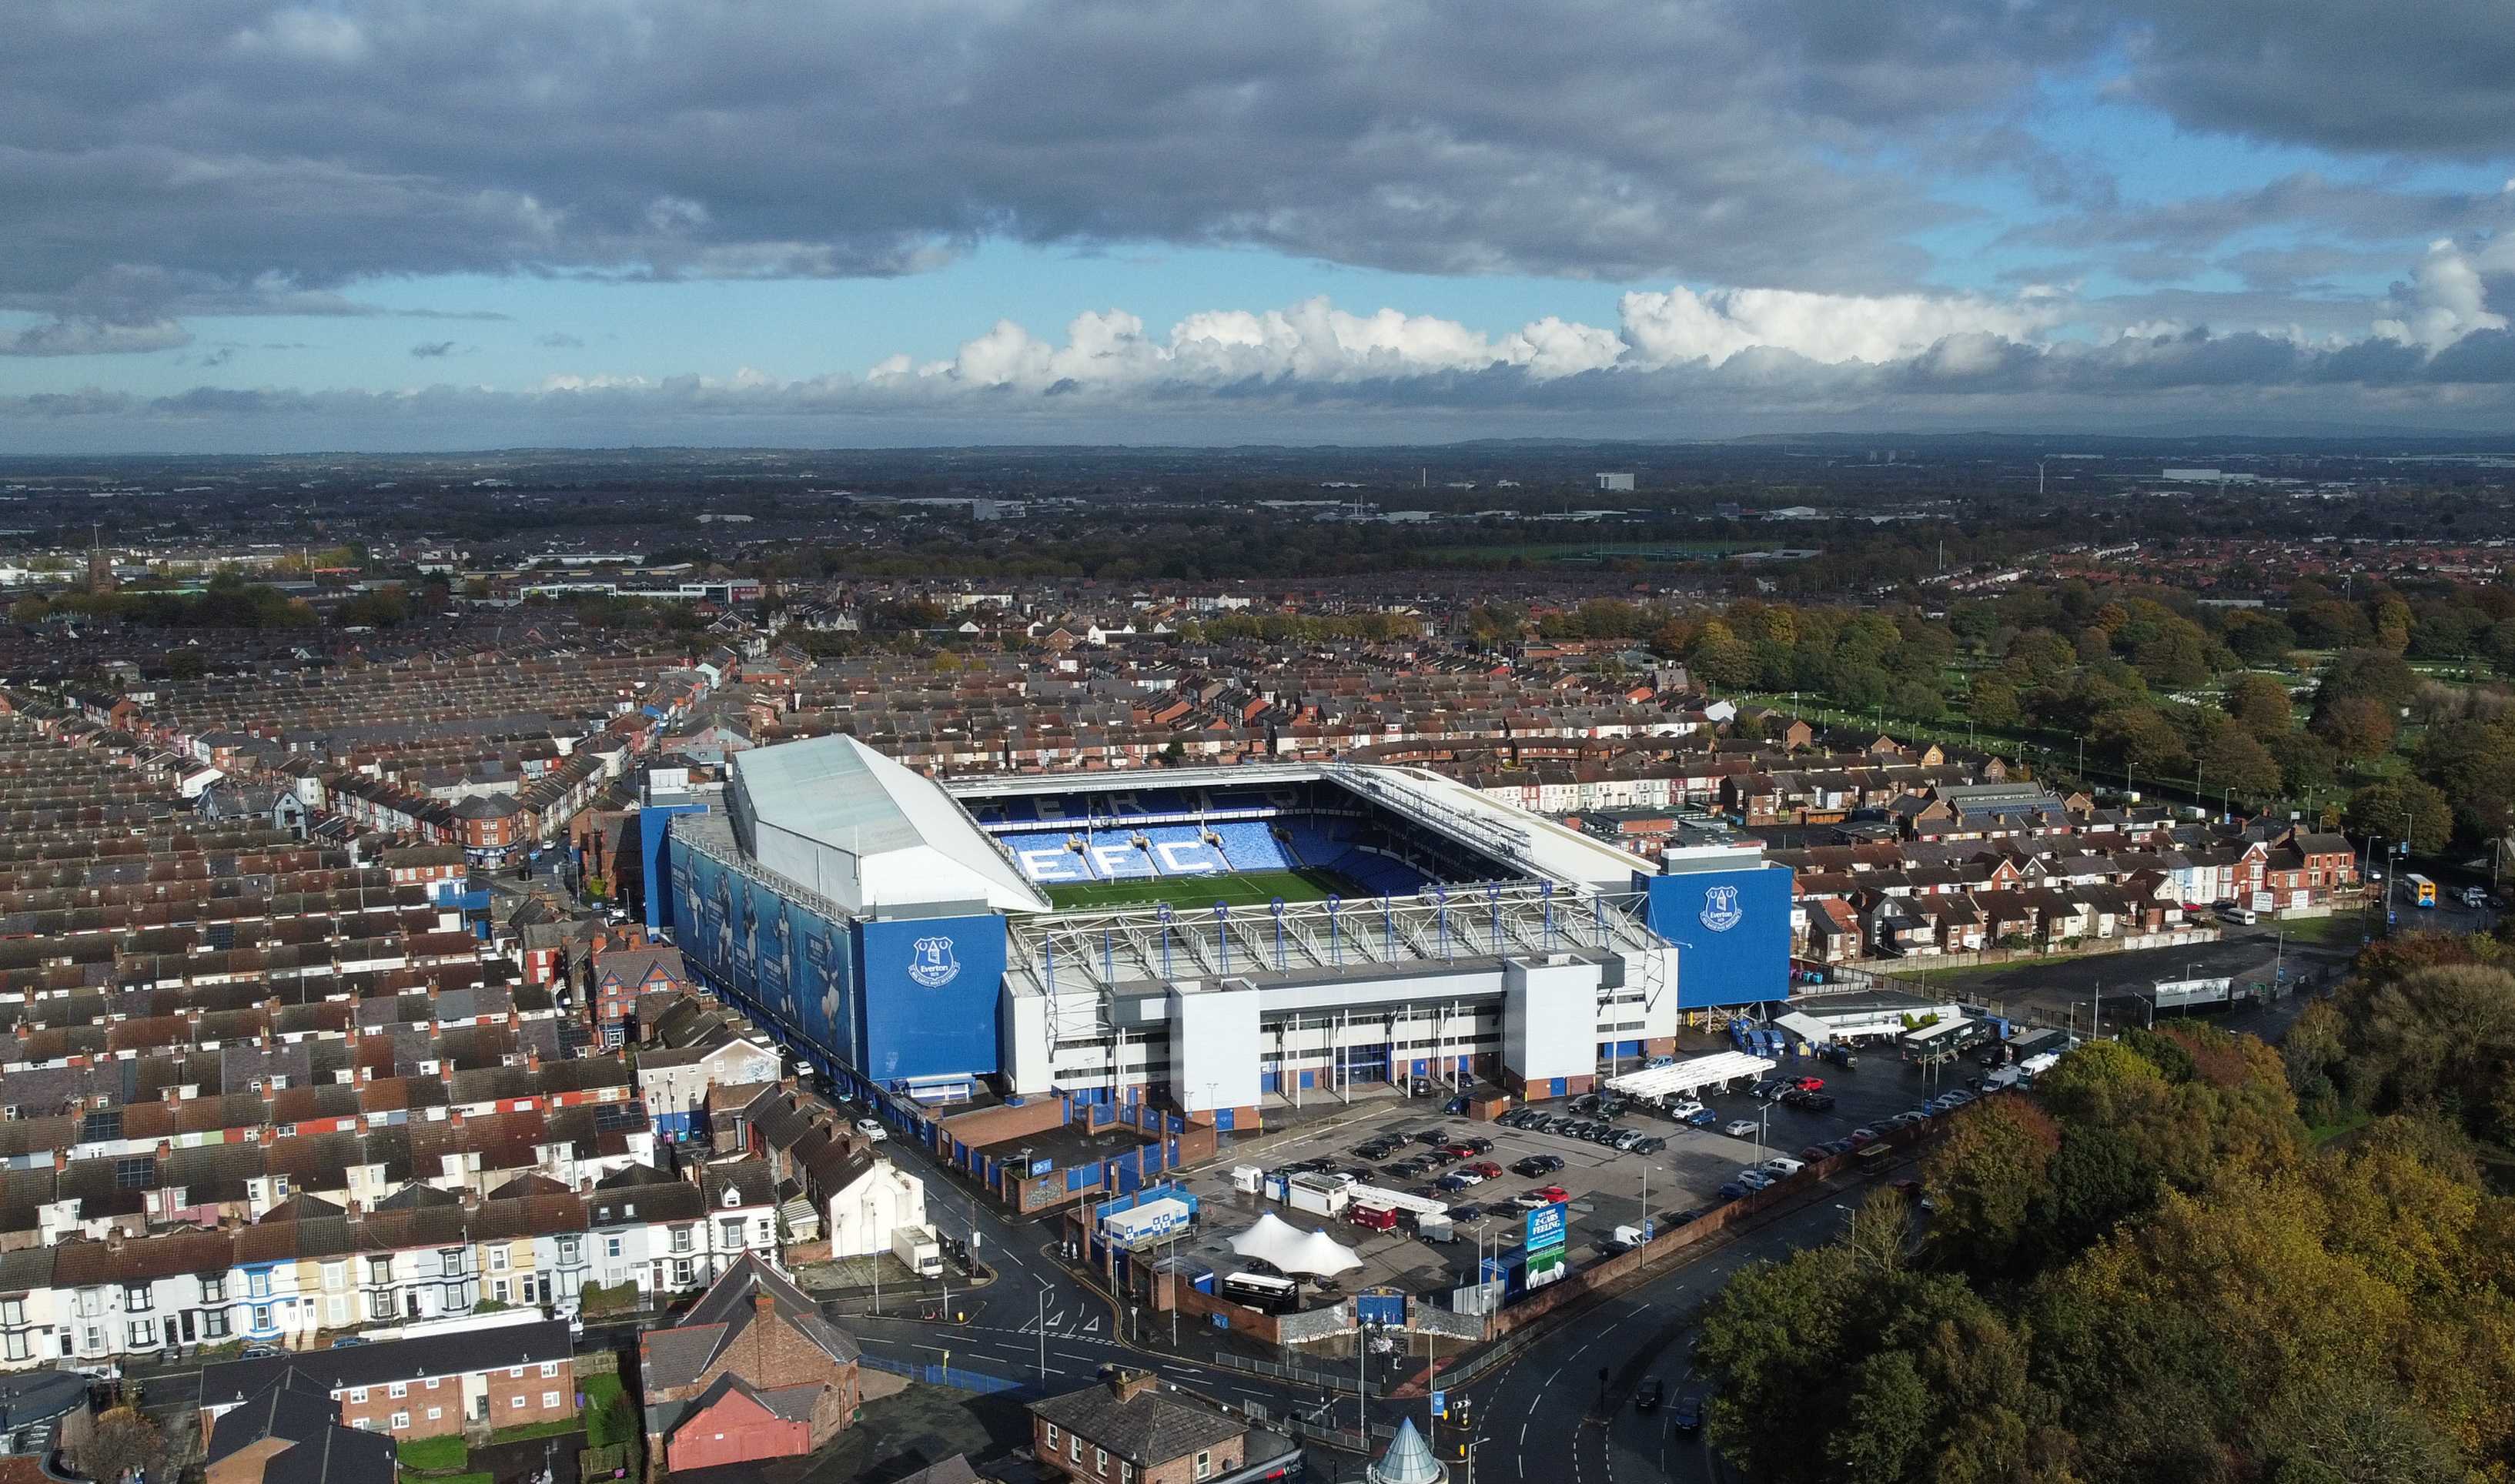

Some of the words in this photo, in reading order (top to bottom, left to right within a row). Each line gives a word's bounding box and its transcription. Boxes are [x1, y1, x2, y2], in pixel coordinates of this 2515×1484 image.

[920, 964, 948, 973] Everton
[1533, 1219, 1561, 1235] FEELING
[1534, 1212, 1559, 1227] Z-CARS
